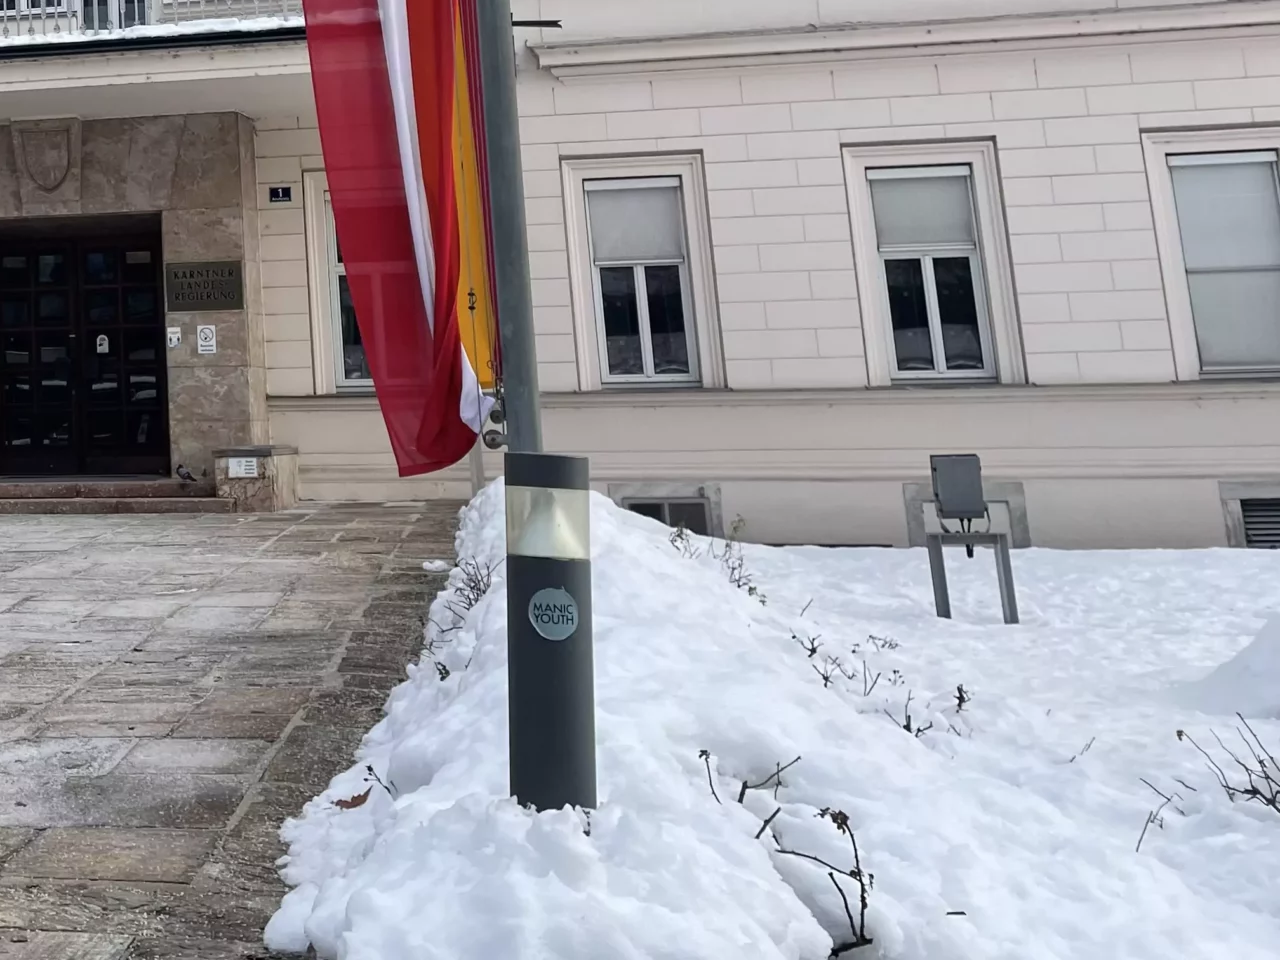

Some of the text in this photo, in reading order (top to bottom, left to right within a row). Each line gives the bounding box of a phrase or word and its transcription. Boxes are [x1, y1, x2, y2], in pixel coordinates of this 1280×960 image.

[277, 188, 283, 198] 1
[174, 290, 236, 302] REGIERUNG
[533, 602, 574, 615] MANIC
[533, 613, 574, 625] YOUTH
